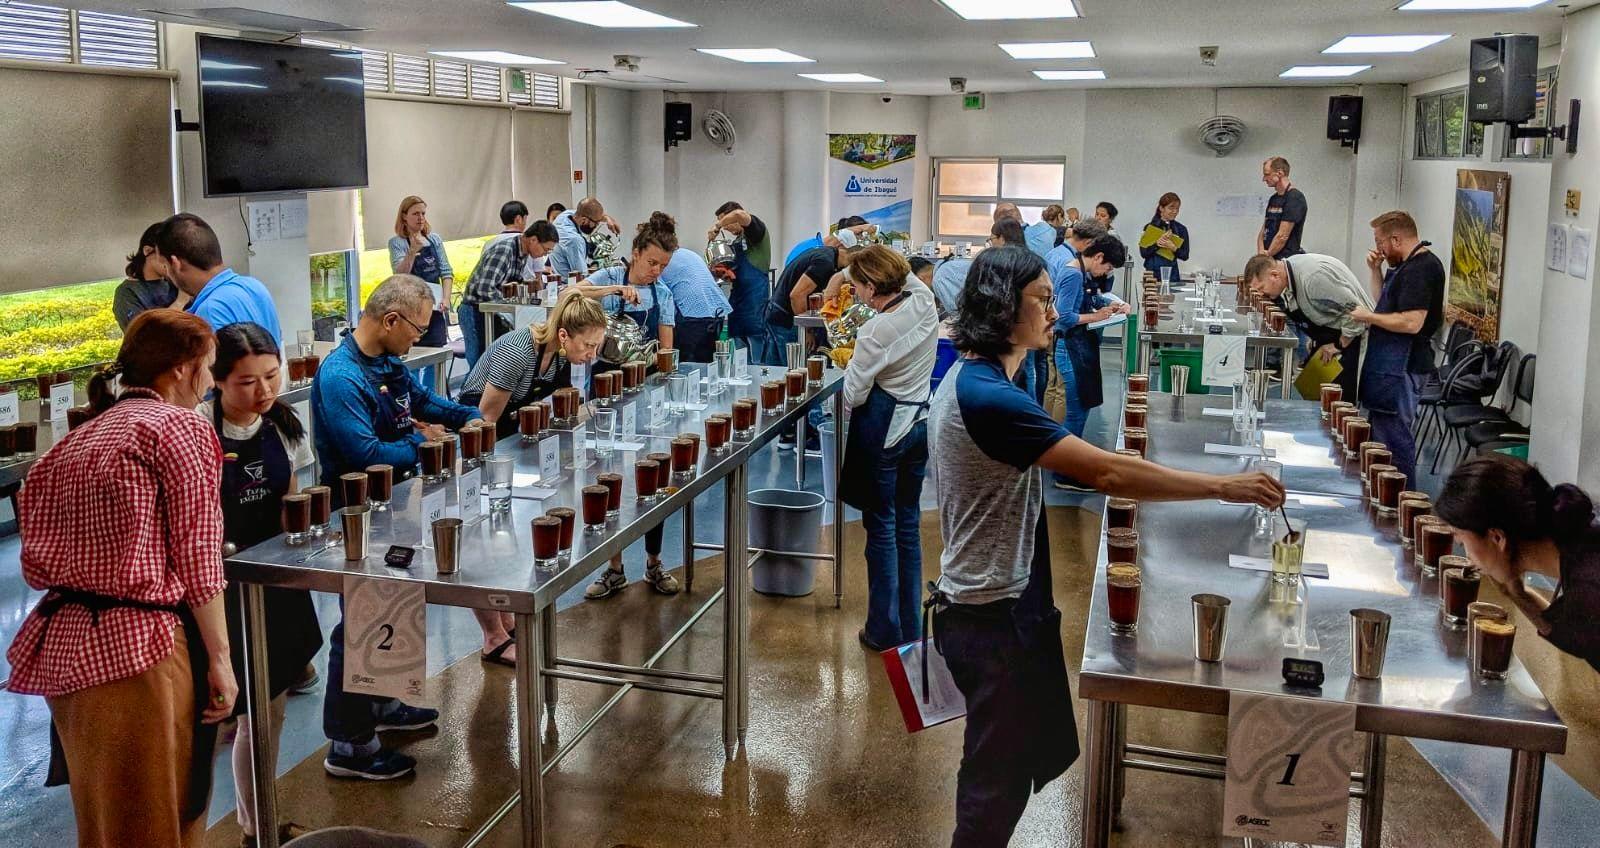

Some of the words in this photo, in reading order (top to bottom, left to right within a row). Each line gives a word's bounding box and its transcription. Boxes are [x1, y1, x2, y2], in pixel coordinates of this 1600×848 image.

[874, 186, 897, 194] Ibagué
[1219, 354, 1228, 366] 4
[377, 623, 394, 651] 2
[1276, 753, 1301, 786] 1
